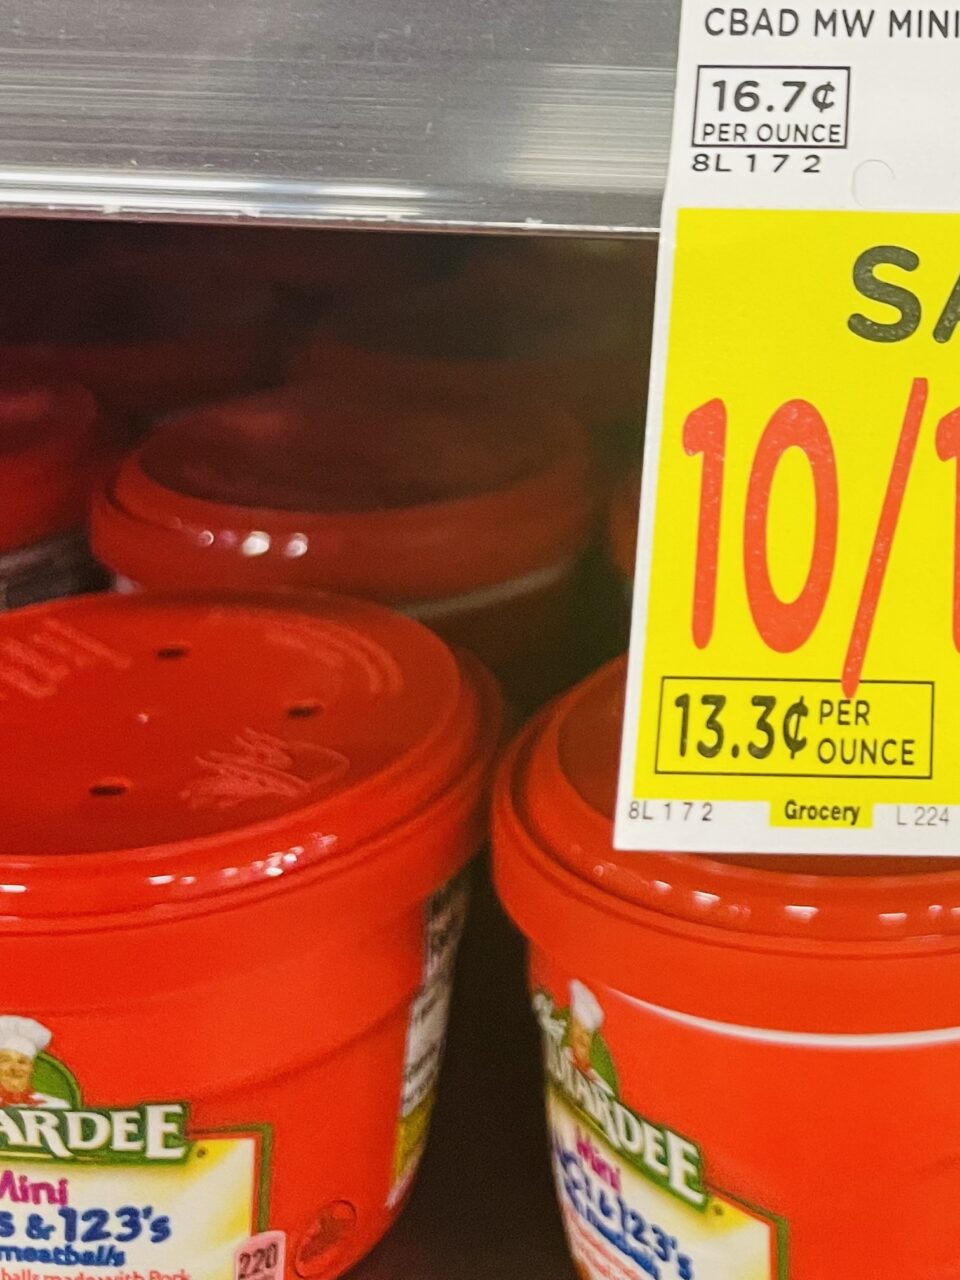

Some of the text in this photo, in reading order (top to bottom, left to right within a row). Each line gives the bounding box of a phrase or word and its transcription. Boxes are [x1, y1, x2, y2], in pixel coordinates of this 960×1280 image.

[705, 8, 799, 37] CBAD
[813, 9, 875, 37] MW
[890, 10, 960, 38] MINI
[713, 80, 836, 115] 16.7¢
[702, 123, 841, 143] PER OUNCE
[692, 153, 732, 173] 8L
[675, 693, 870, 760] 13.3¢ PER
[817, 738, 916, 766] OUNCE
[628, 802, 653, 820] 8L
[784, 798, 860, 826] Grocery
[914, 806, 949, 827] 224
[58, 1206, 172, 1243] 123's
